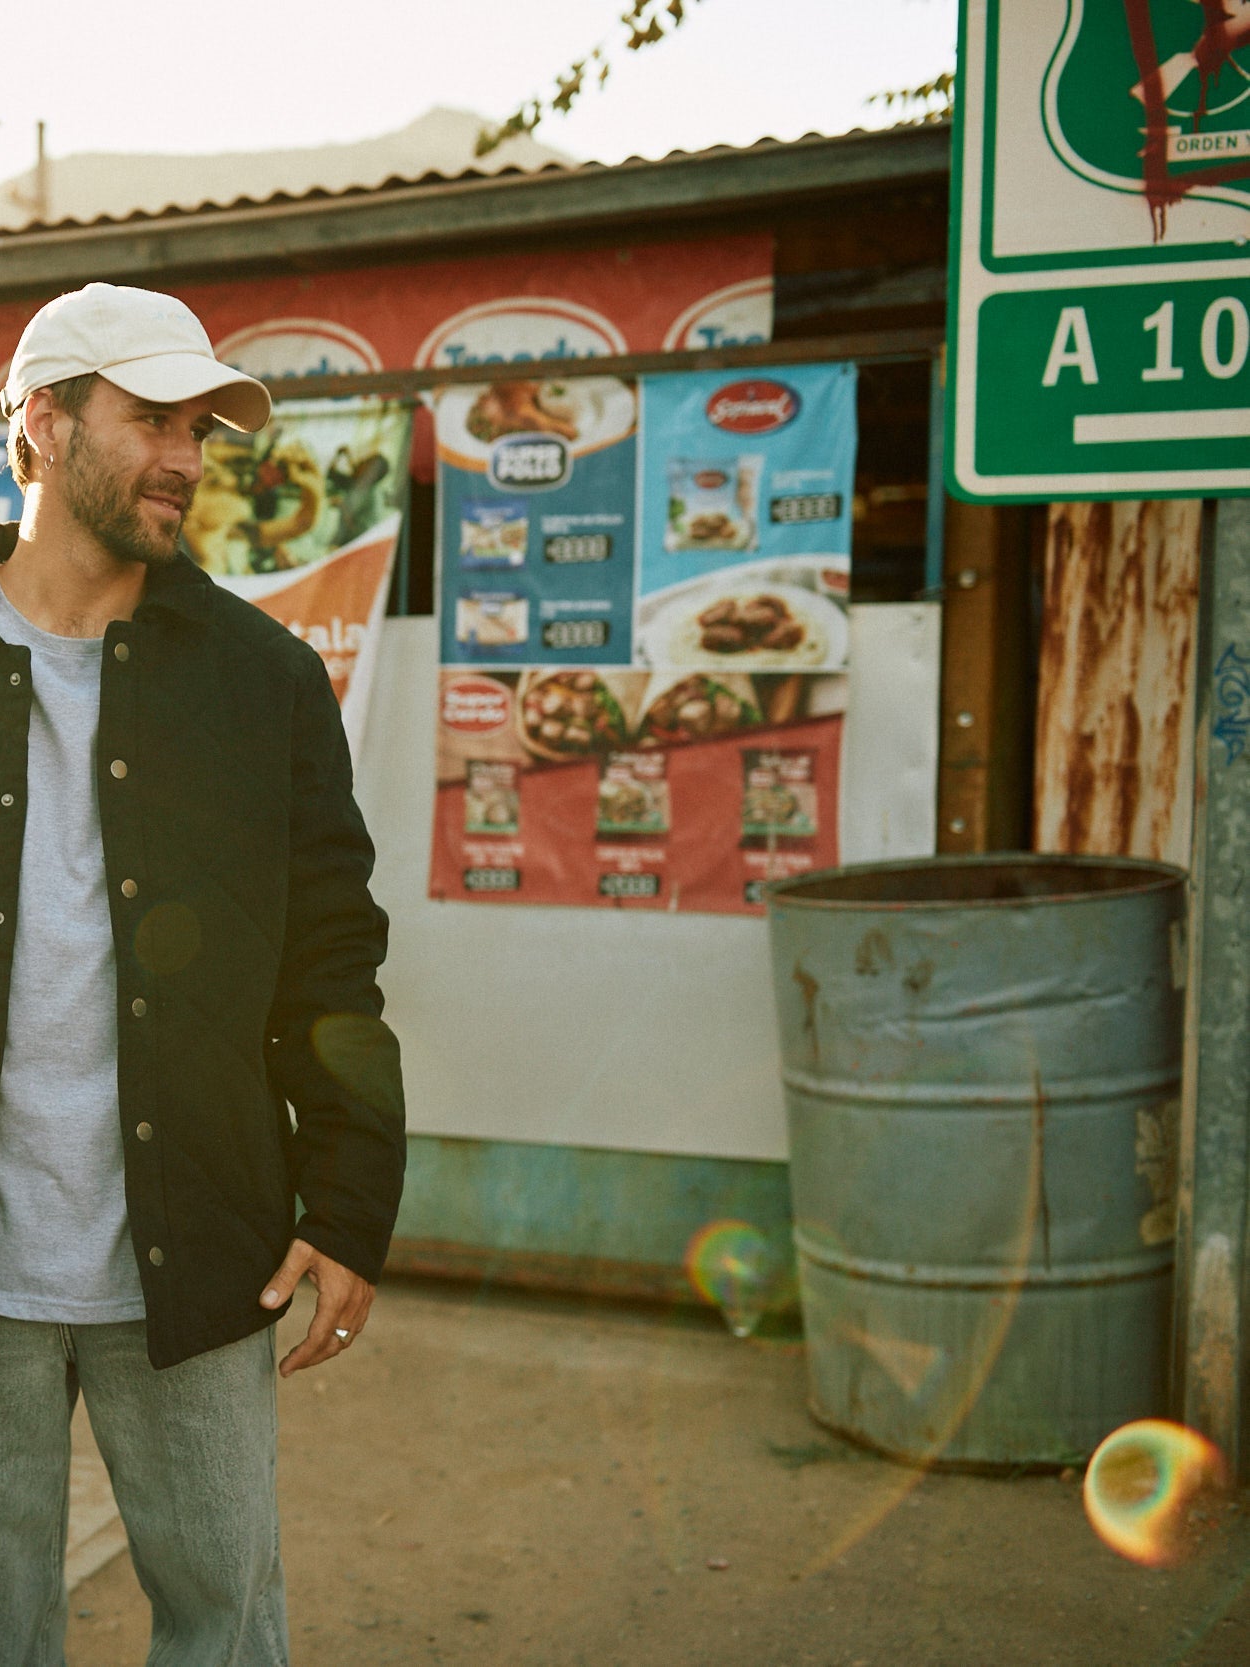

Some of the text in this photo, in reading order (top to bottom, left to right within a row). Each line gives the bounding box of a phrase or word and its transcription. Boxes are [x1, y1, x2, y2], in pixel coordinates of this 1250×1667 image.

[1176, 134, 1238, 154] ORDEN
[1041, 296, 1250, 388] A 10
